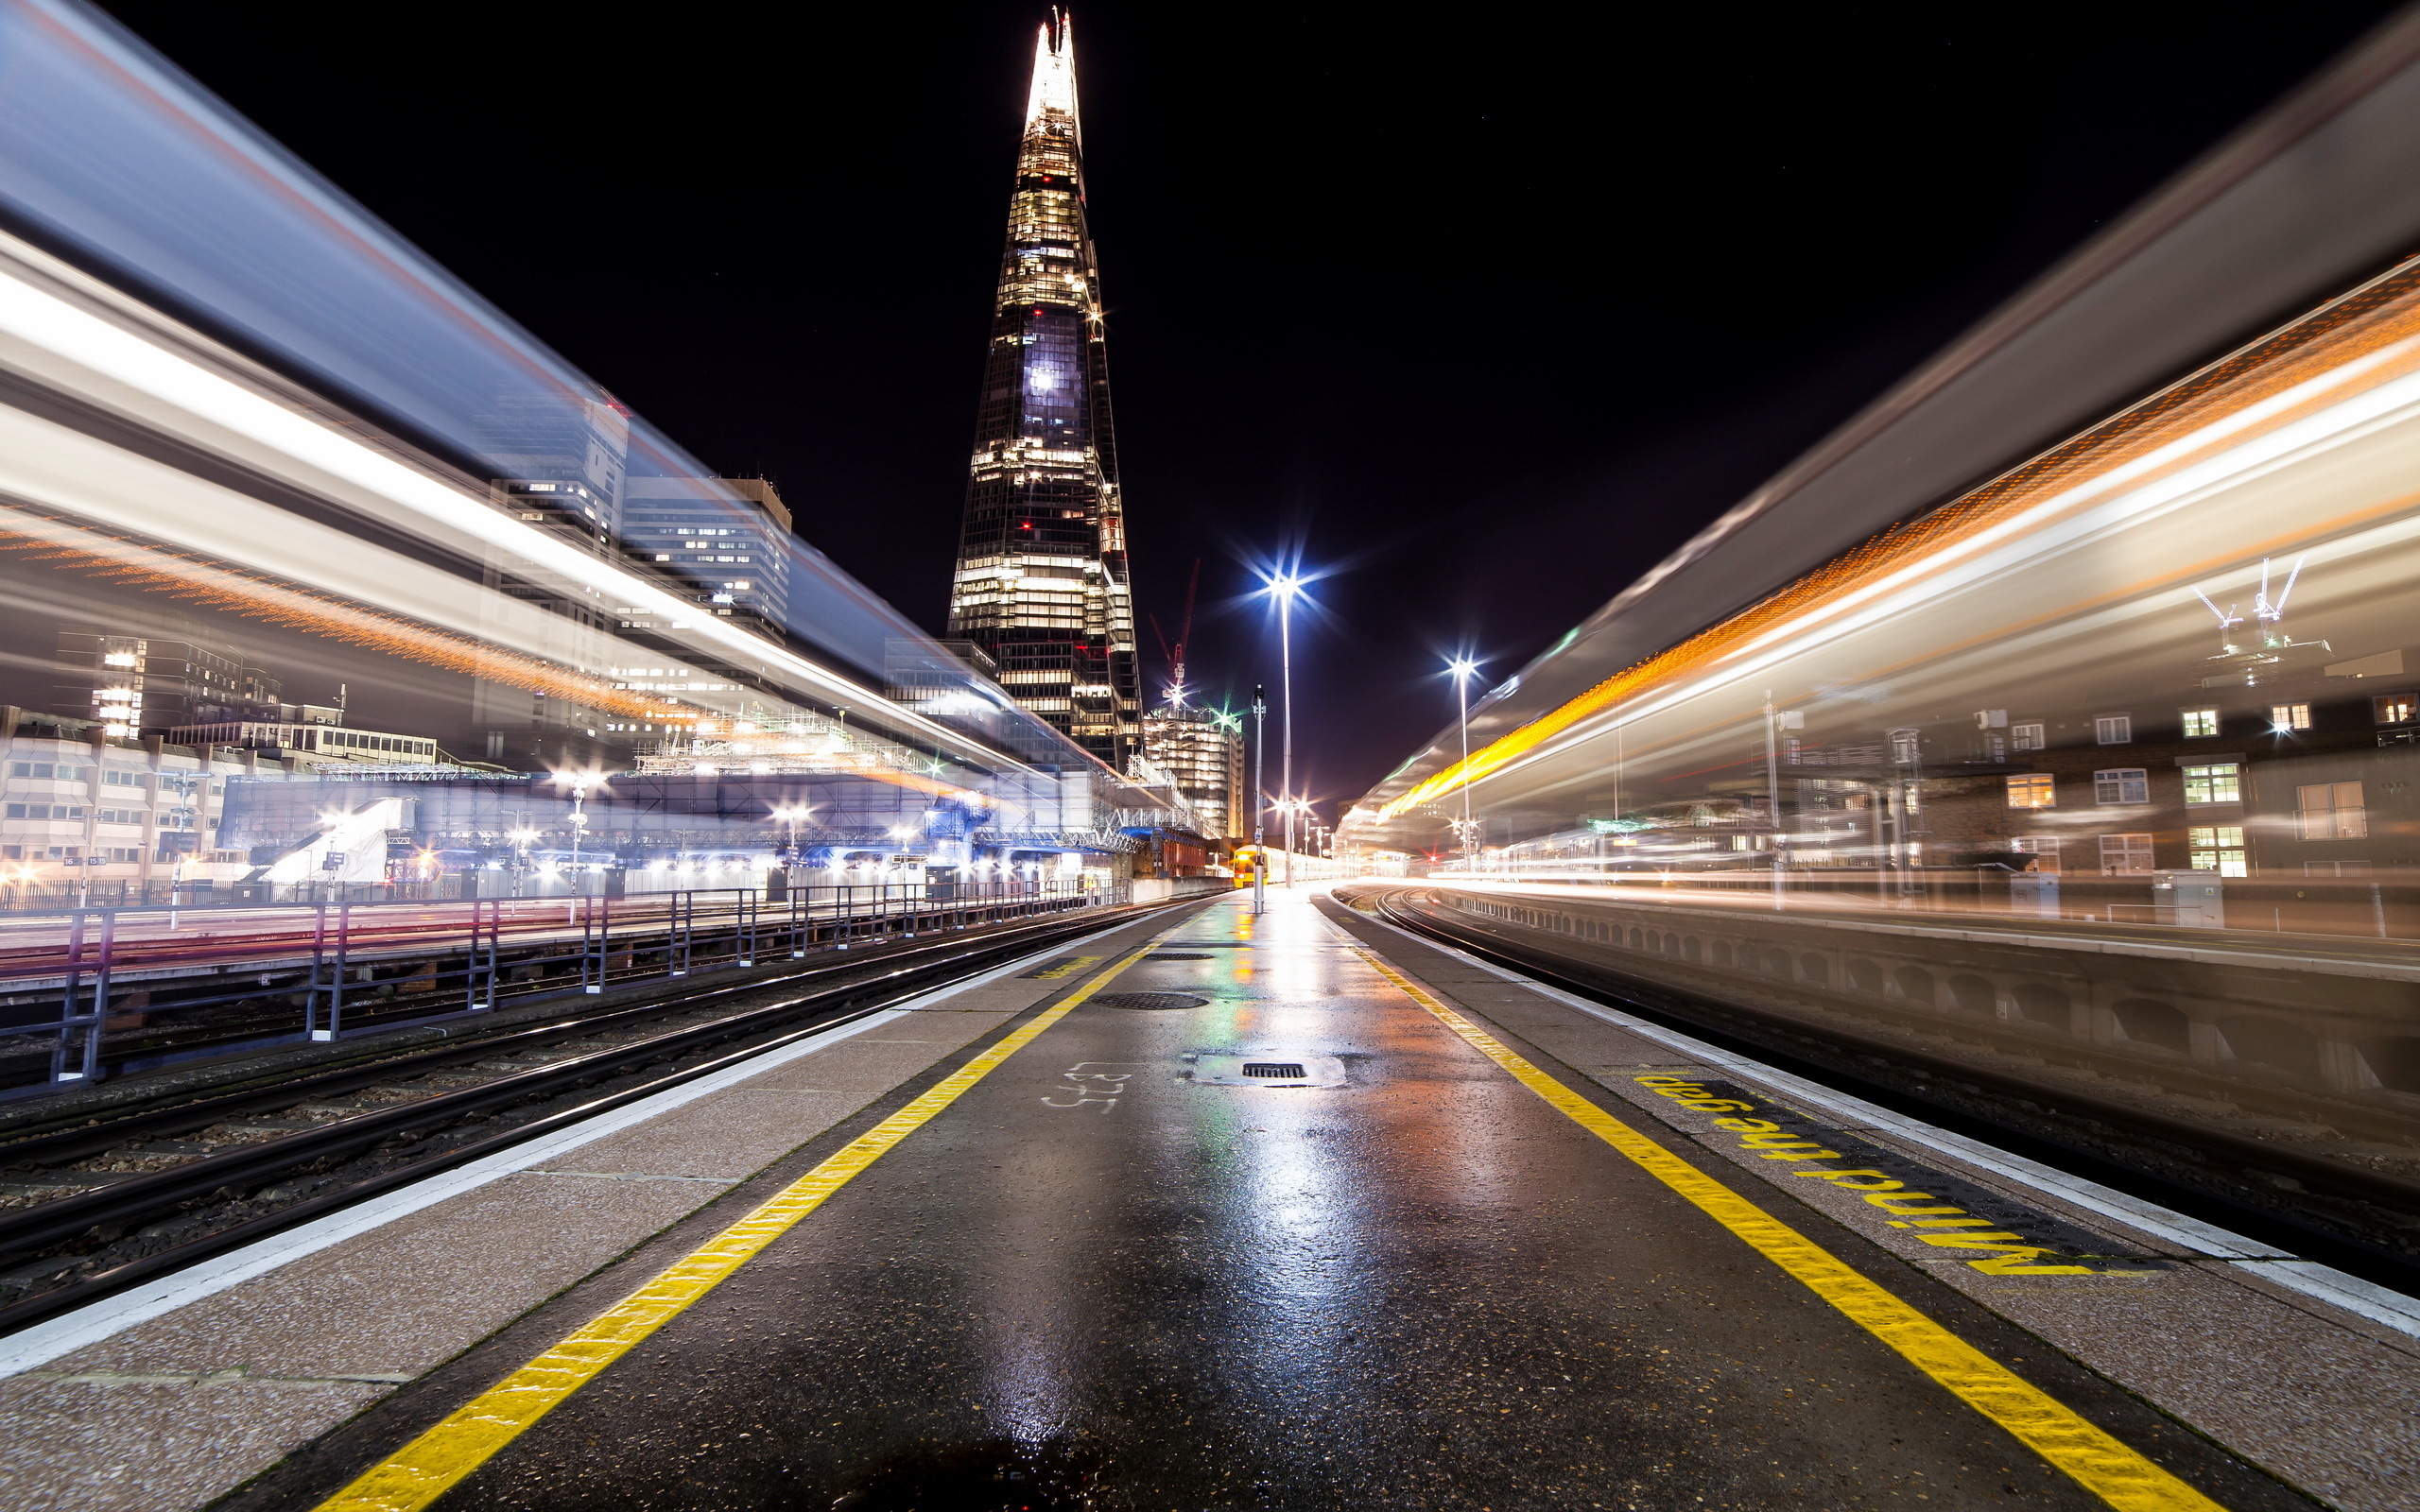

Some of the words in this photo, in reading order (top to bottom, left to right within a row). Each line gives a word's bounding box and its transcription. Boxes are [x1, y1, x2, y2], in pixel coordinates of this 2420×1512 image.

[1633, 1074, 1754, 1113] gap
[1713, 1116, 1842, 1163] the
[1791, 1168, 2096, 1276] Mind
